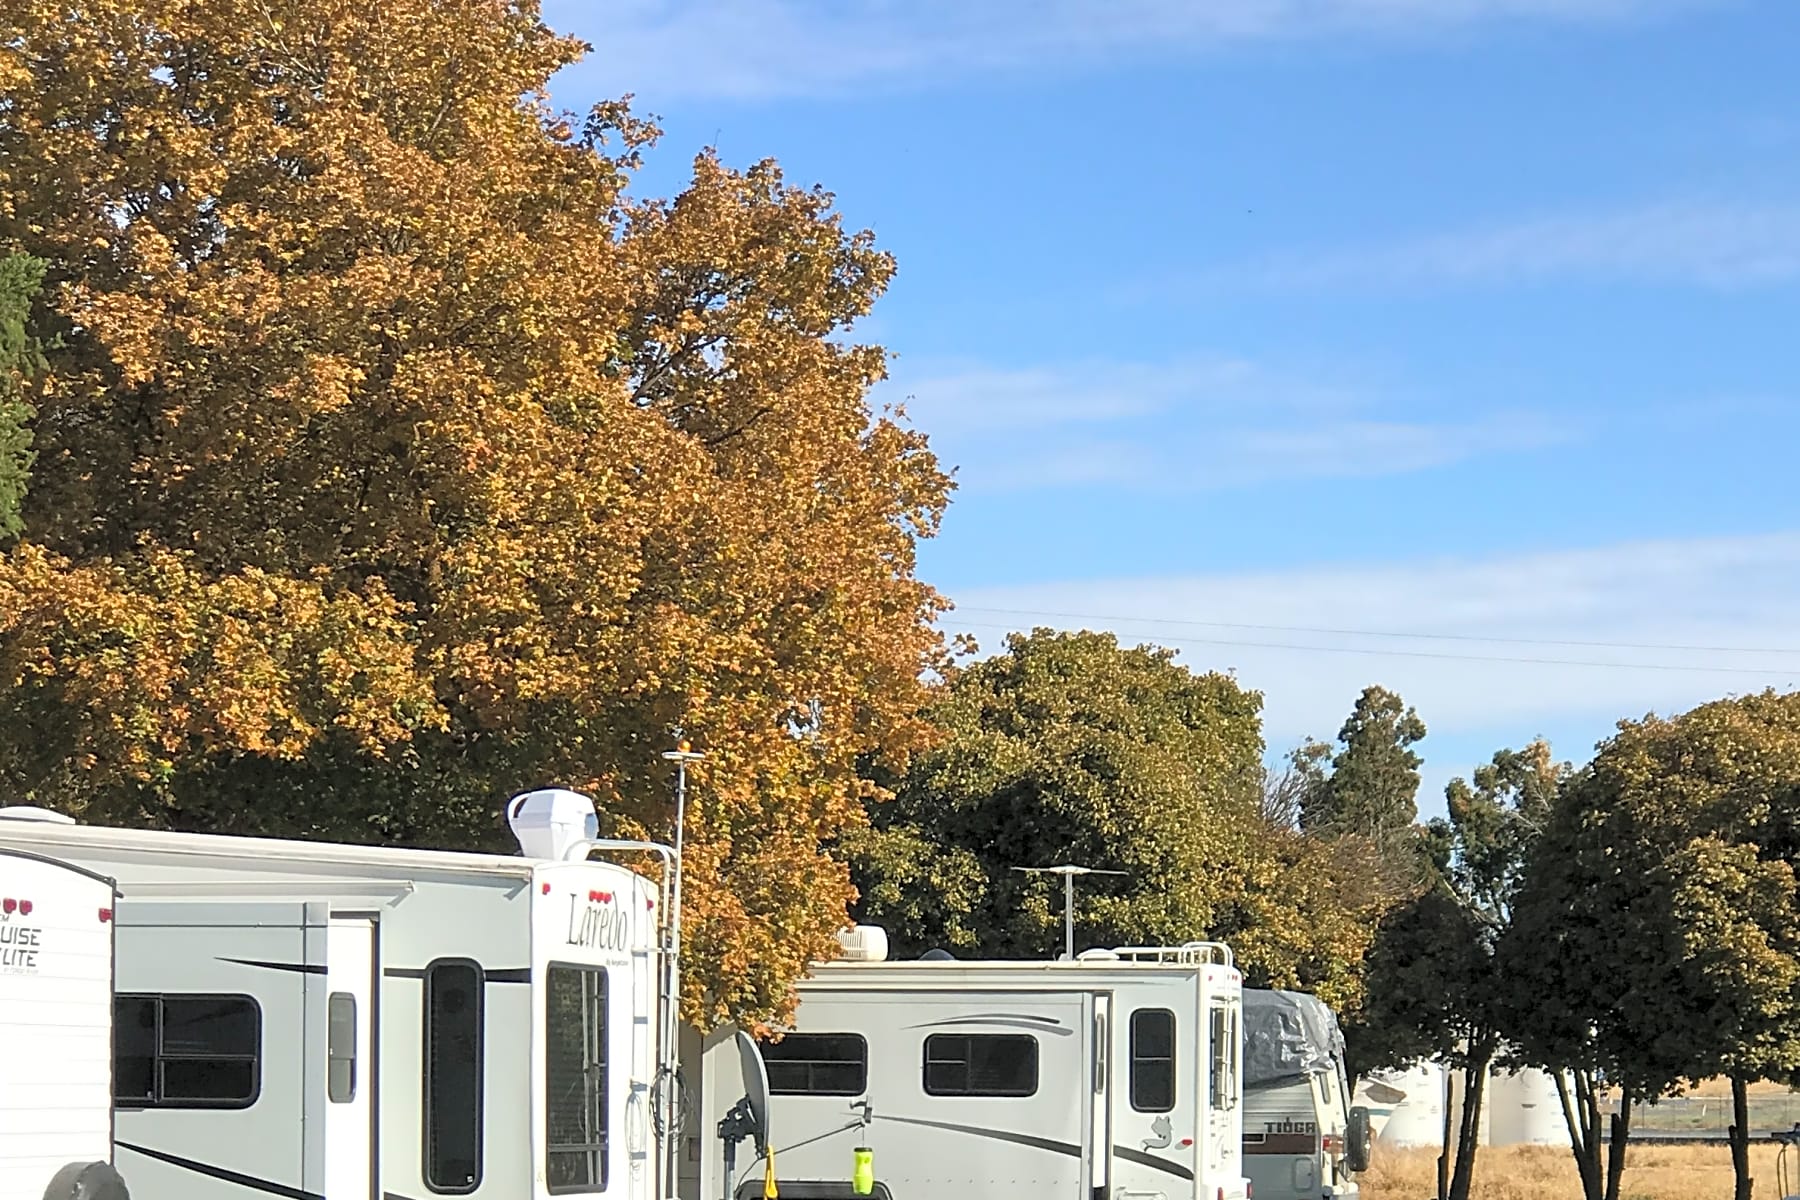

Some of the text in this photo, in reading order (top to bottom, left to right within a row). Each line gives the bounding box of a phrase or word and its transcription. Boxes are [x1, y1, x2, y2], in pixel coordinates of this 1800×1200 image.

[566, 890, 628, 951] Laredo
[0, 946, 39, 967] LITE
[1264, 1116, 1316, 1134] TIOGA
